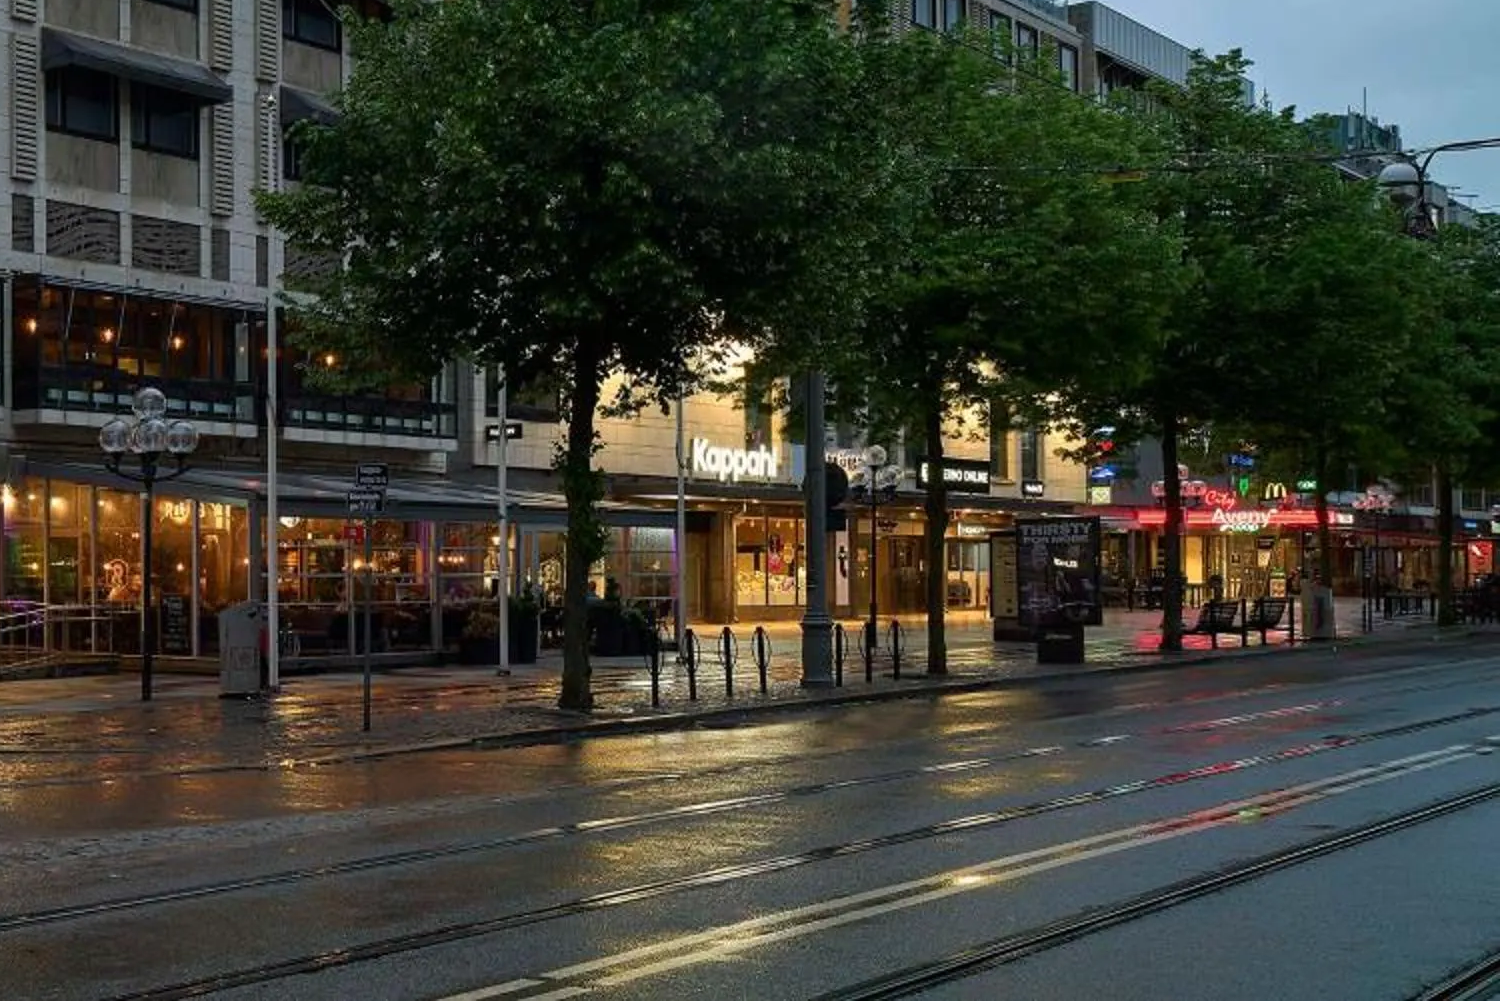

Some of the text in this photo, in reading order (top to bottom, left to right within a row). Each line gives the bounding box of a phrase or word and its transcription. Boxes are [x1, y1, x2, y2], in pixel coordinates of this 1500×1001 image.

[692, 438, 778, 482] Kappahl
[1204, 489, 1238, 511] City
[1211, 507, 1278, 528] Aveny
[1019, 522, 1092, 536] THIRSTY
